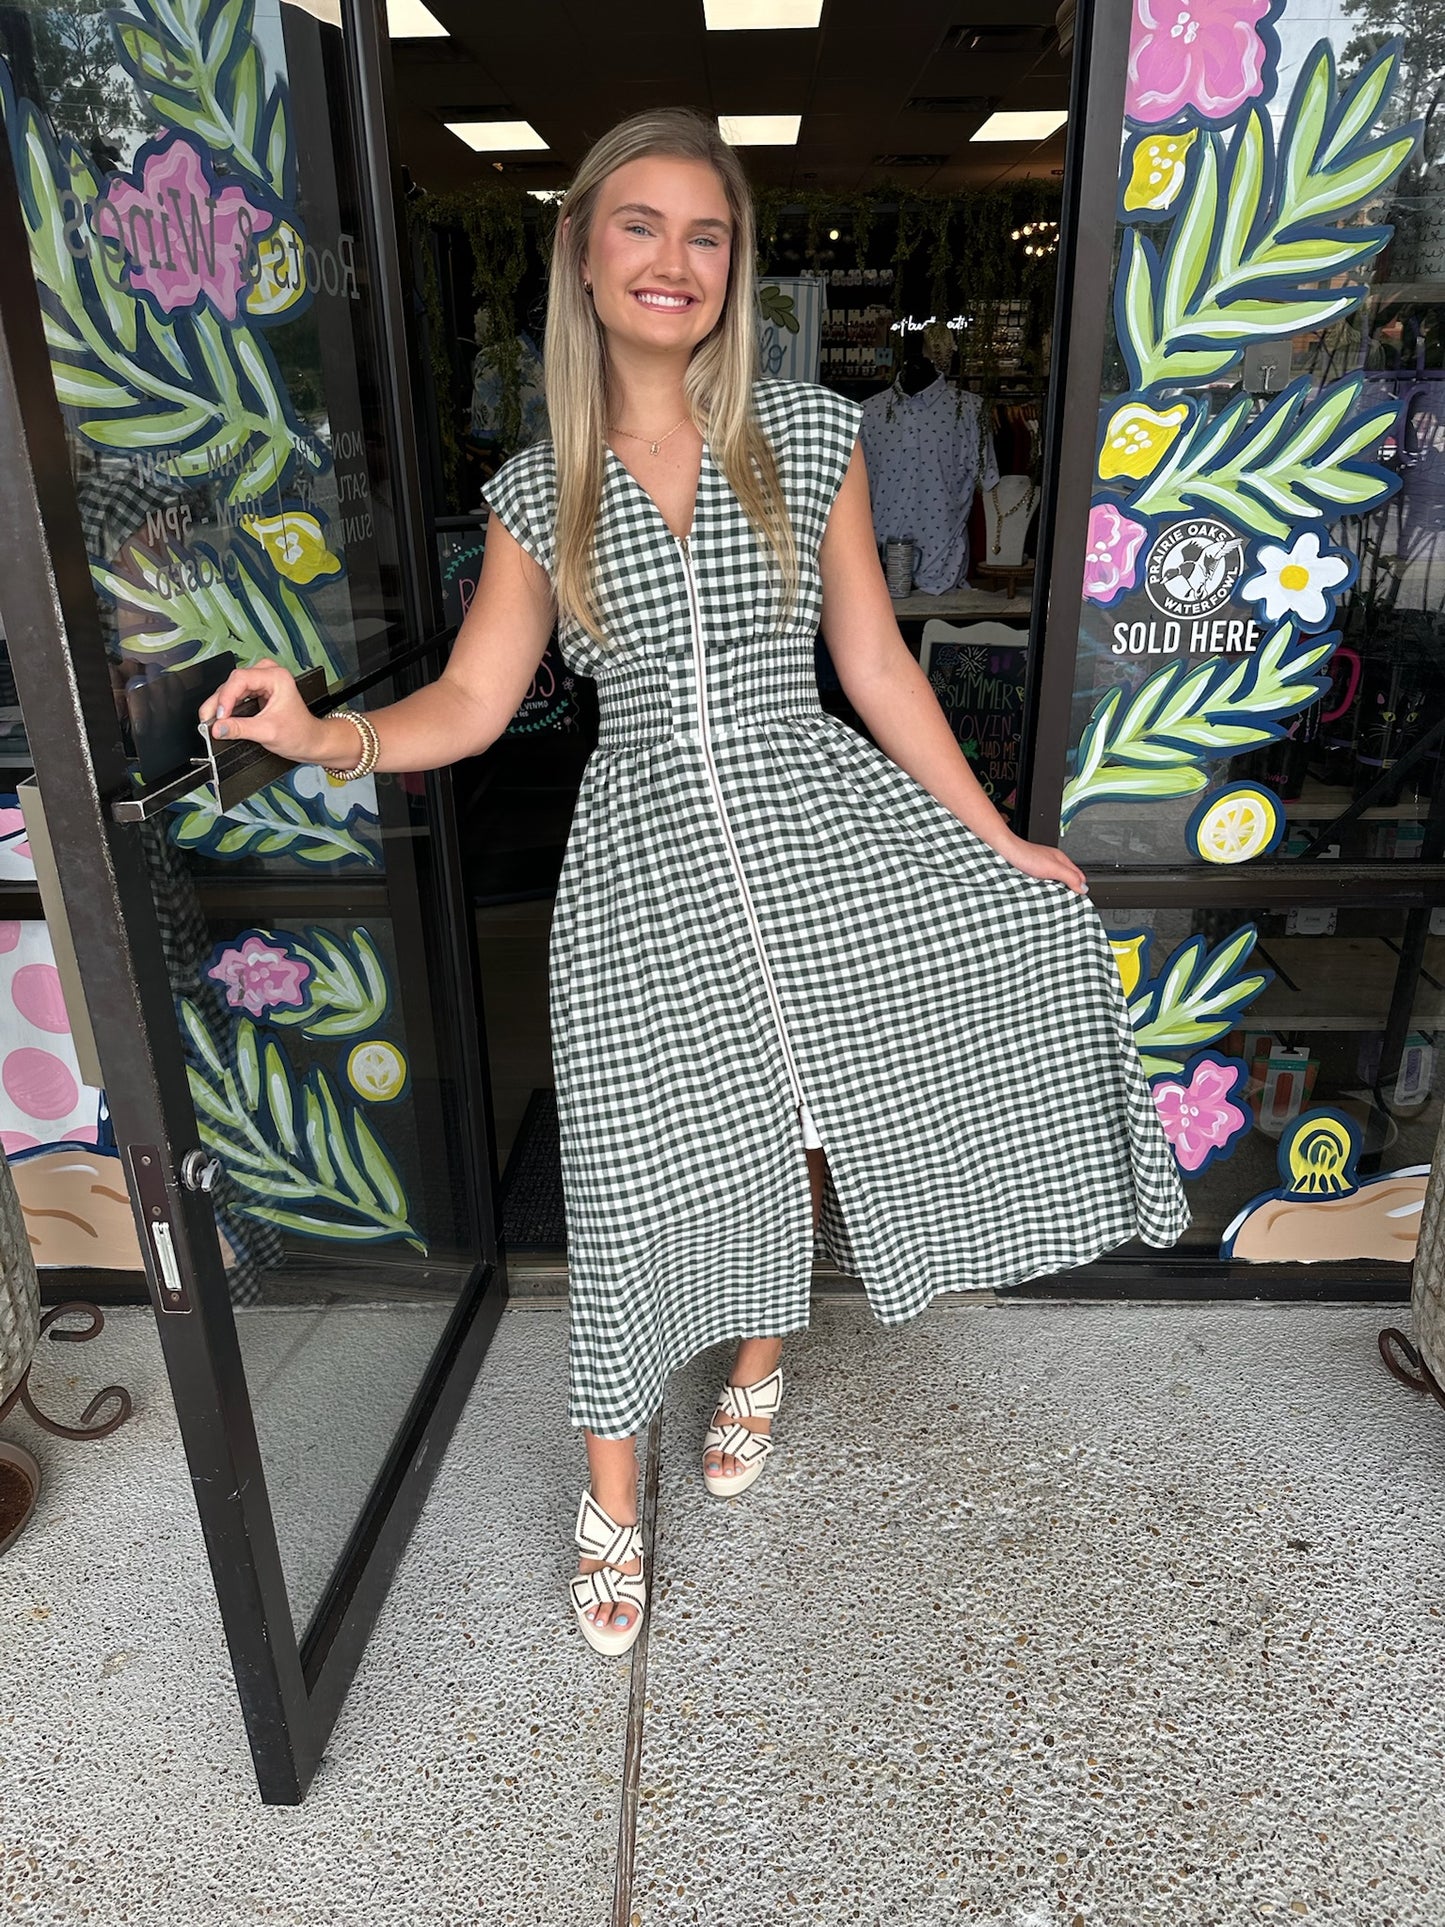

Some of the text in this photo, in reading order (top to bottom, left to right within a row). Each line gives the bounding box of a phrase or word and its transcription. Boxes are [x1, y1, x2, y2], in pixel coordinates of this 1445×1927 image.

[1149, 524, 1228, 585] PRAIRIE OAKS
[1163, 566, 1238, 615] WATERFOWL
[1111, 619, 1260, 655] SOLD HERE
[946, 674, 1013, 709] SUMMER
[980, 740, 1001, 759] HAD
